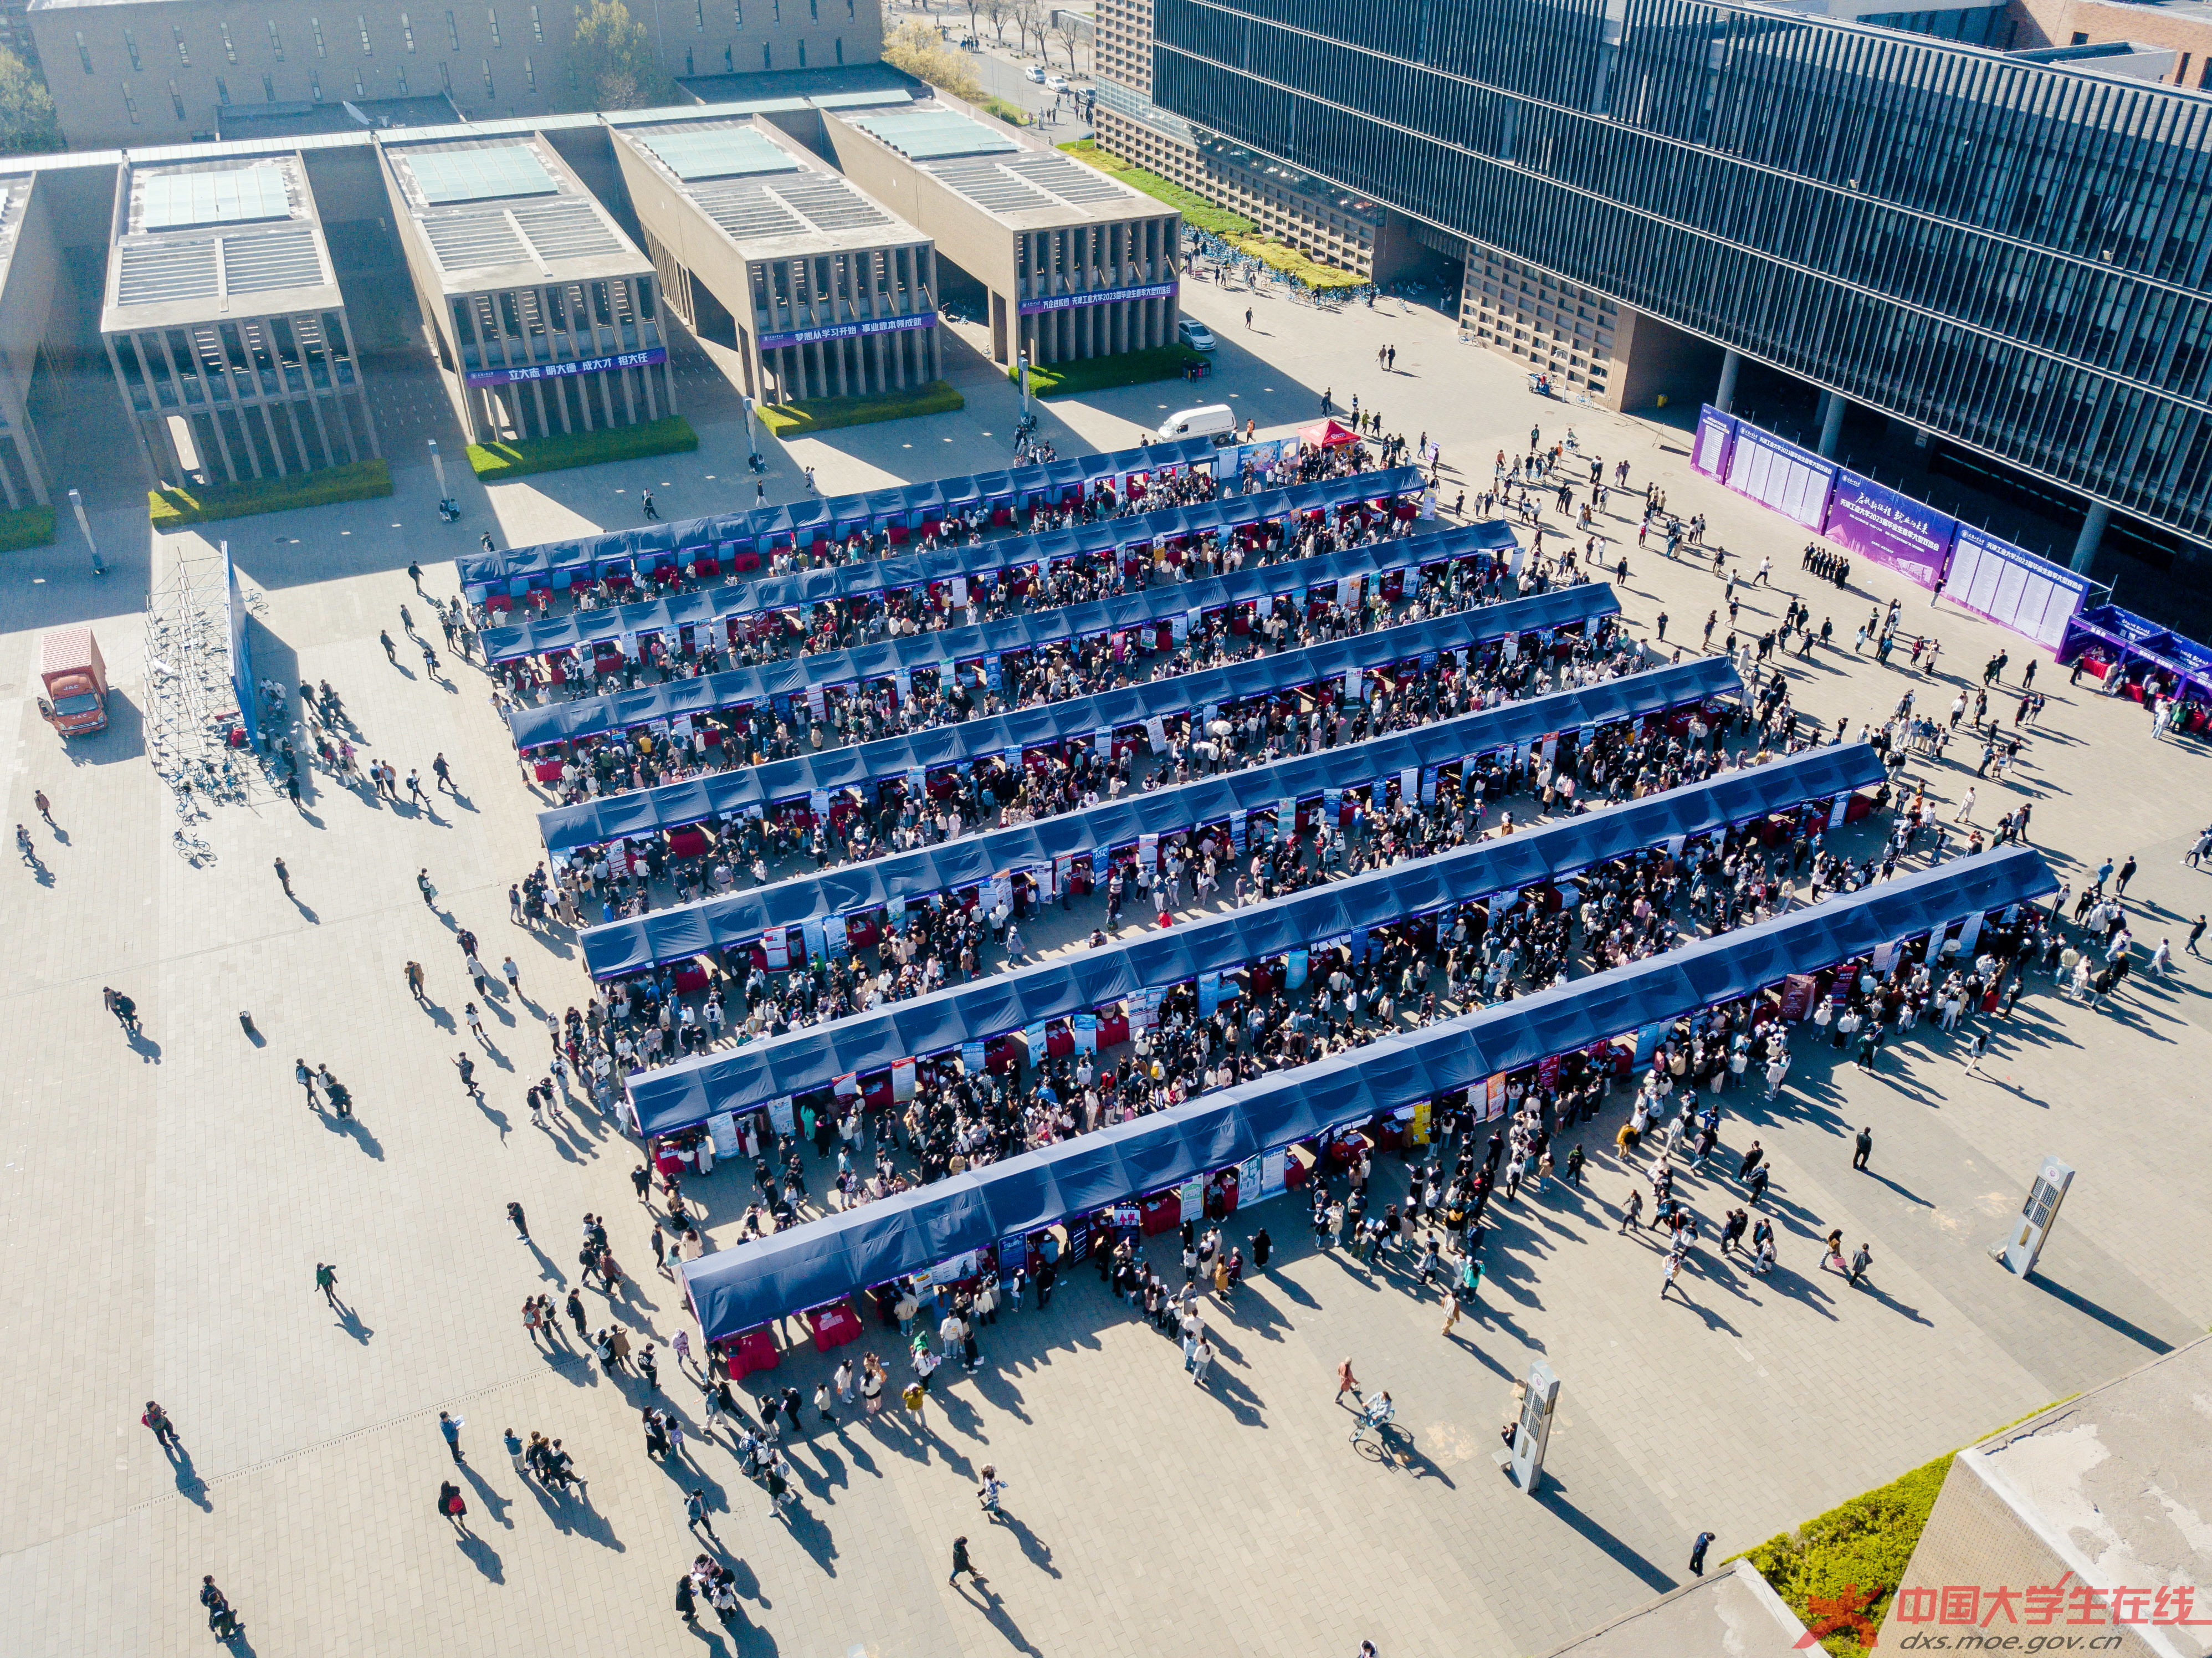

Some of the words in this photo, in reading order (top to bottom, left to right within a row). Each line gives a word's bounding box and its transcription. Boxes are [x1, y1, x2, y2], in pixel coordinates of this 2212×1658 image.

[1043, 298, 1069, 309] 万企进校园
[1072, 285, 1171, 305] 天津工业大学2023届毕业生春季大型双选会
[795, 326, 857, 341] 梦想从学习开始
[862, 318, 922, 332] 事业靠本领成就
[509, 367, 540, 381] 立大志
[545, 363, 577, 376] 明大德
[582, 358, 612, 371] 成大才
[618, 352, 648, 366] 担大任
[1840, 498, 1939, 551] 天津工业大学2023届毕业生春季大型双选会
[1855, 492, 1892, 516] 启航新征程
[1893, 510, 1928, 535] 就业向未来
[1986, 542, 2083, 591] 天津工业大学2023届毕业生春季大型双选会
